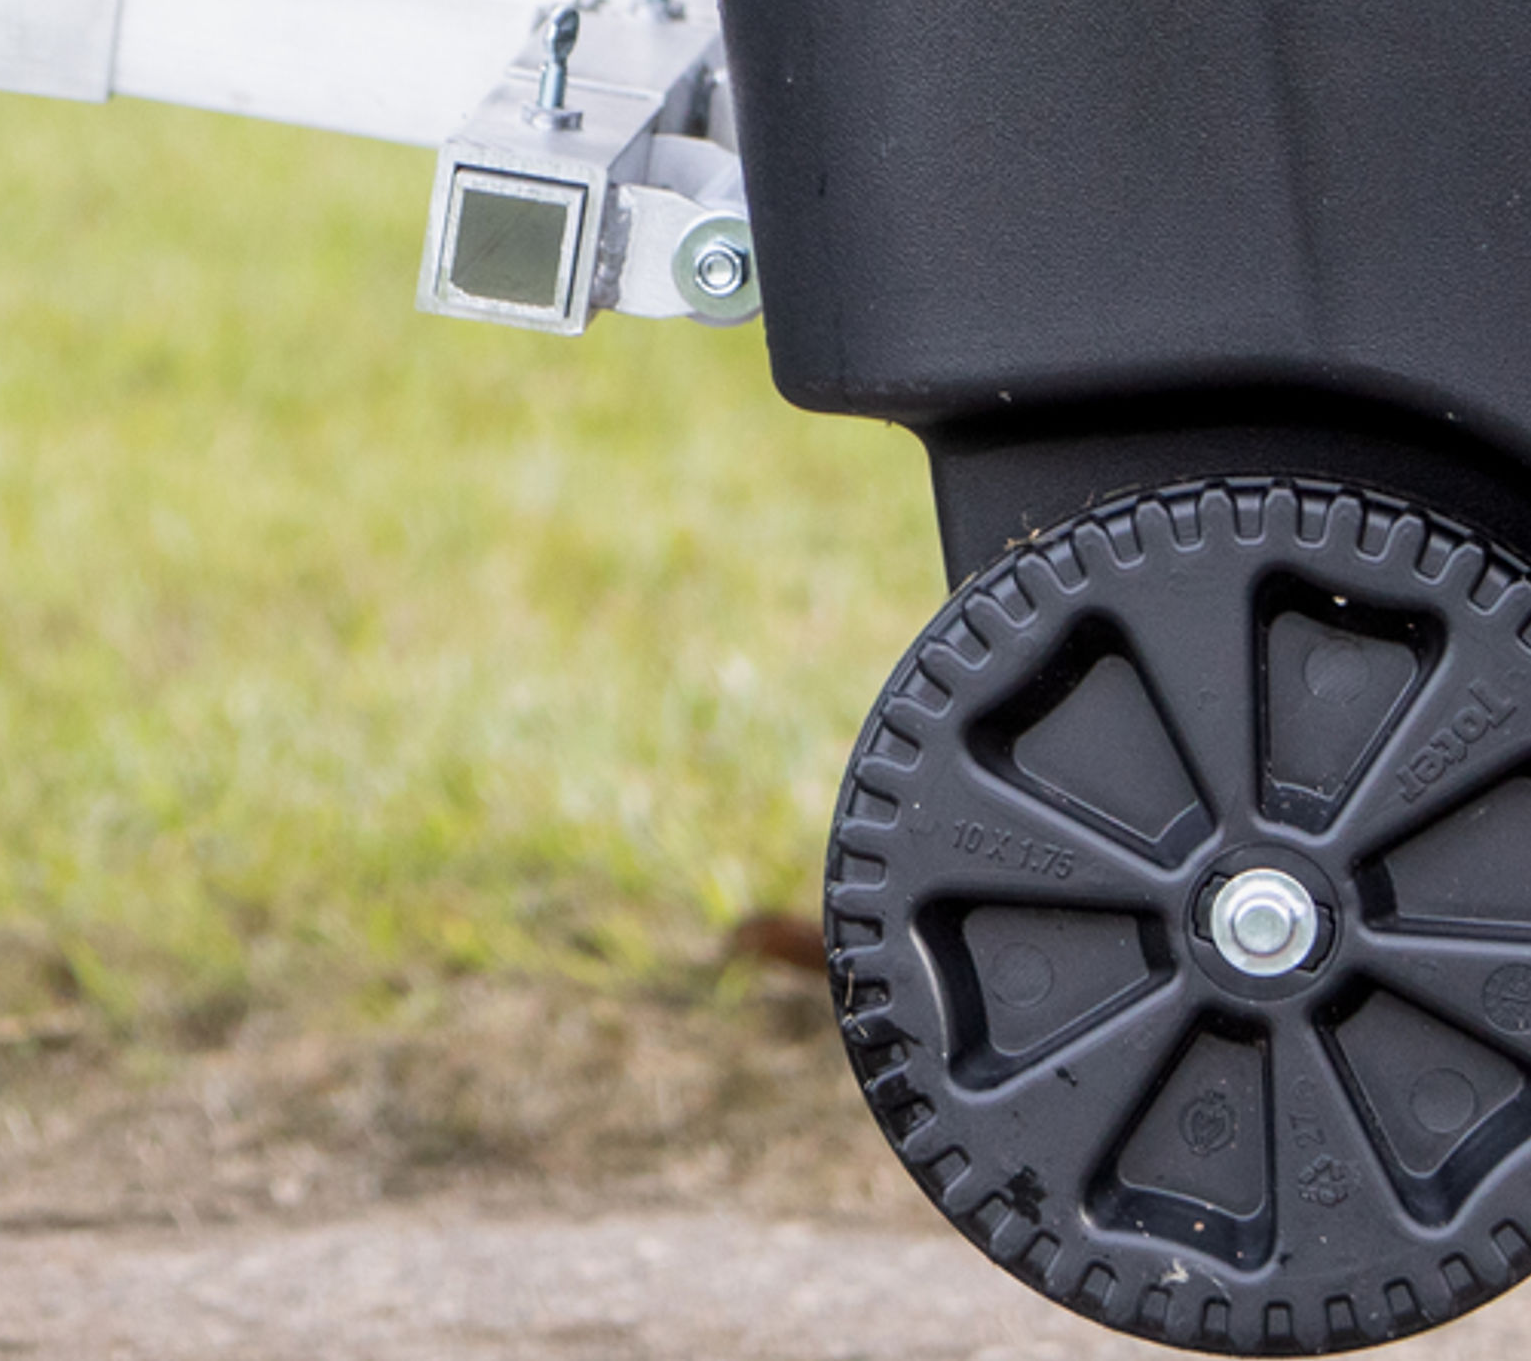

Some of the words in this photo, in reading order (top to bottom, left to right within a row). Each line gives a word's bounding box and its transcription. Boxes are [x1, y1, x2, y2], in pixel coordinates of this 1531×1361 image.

[1395, 679, 1518, 804] Toter
[952, 818, 985, 855] 10
[1017, 837, 1076, 880] 1.75
